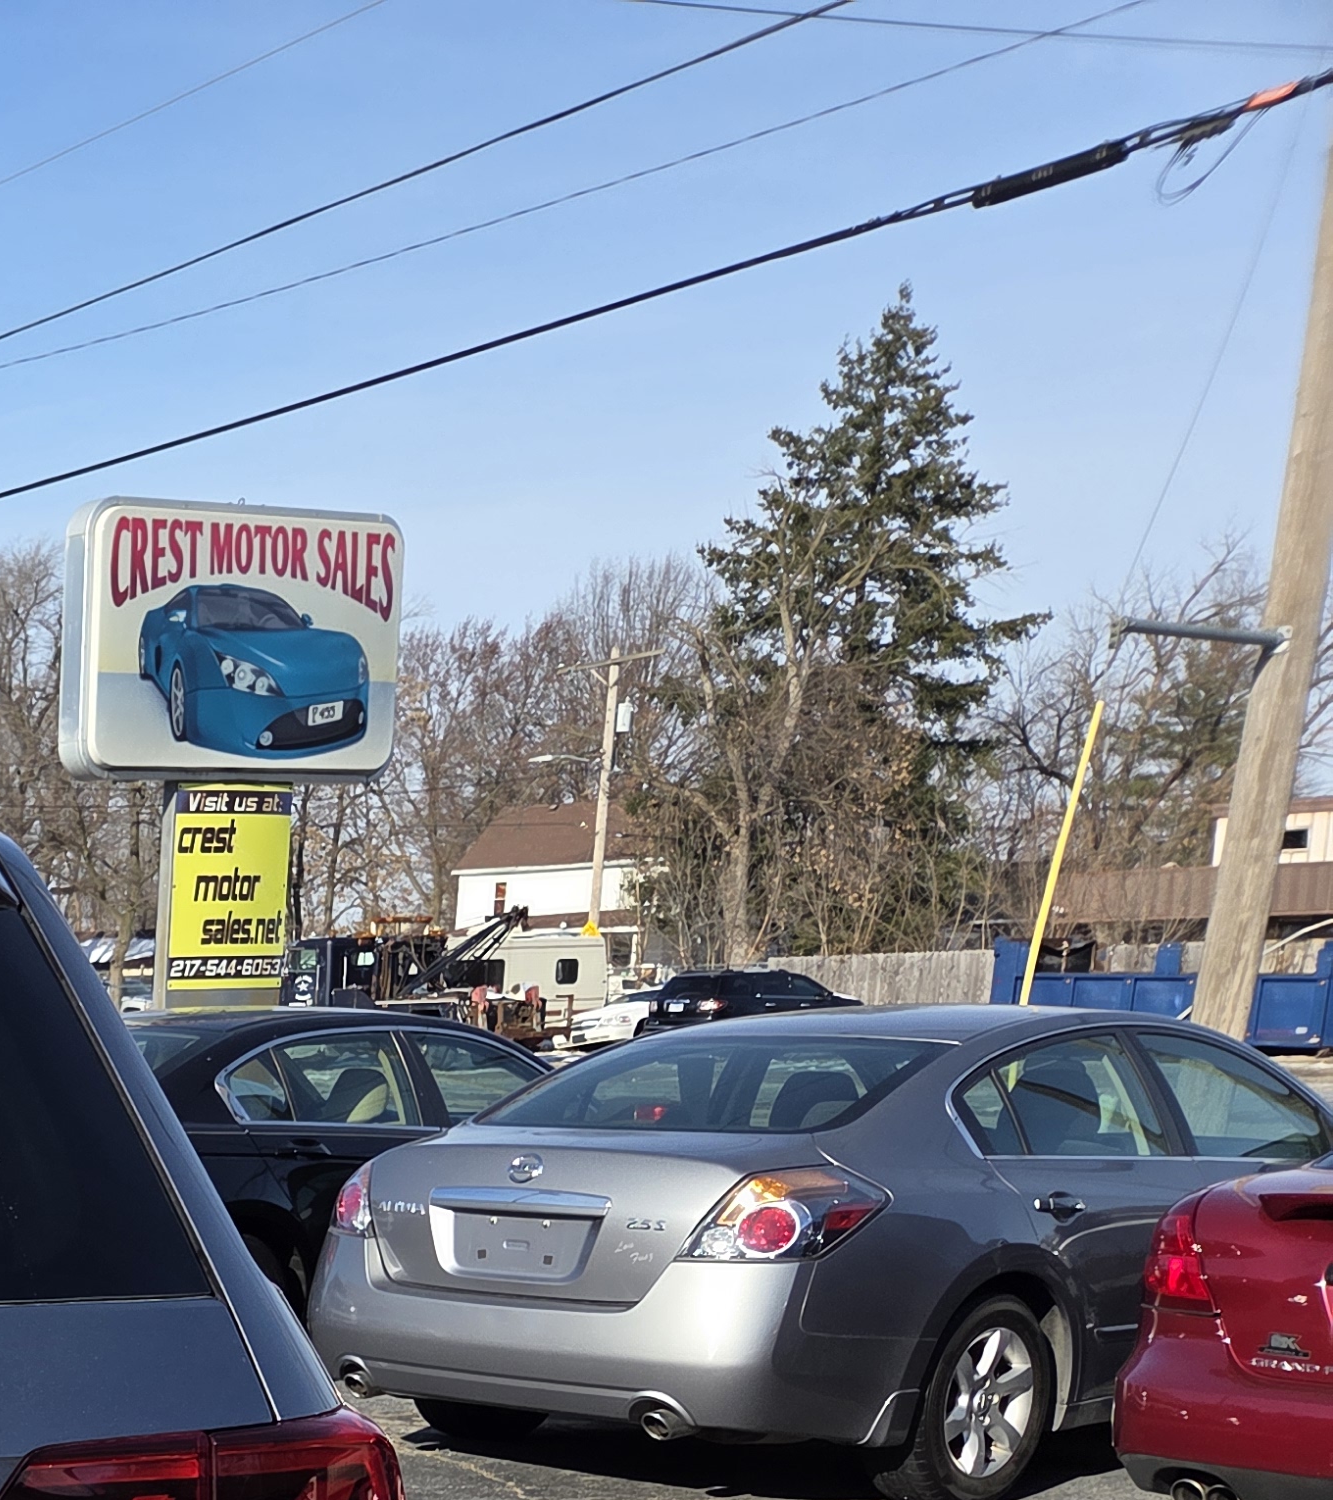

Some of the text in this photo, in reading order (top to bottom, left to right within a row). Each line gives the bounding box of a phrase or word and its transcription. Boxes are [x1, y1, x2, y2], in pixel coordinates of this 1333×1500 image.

[110, 515, 396, 622] CREST MOTOR SALES
[189, 792, 284, 812] Visit us at:
[177, 818, 236, 854] crest
[193, 867, 261, 902] motor
[200, 910, 283, 945] sales.net
[169, 958, 280, 978] 217-544-6053
[1250, 1357, 1321, 1373] GRAND
